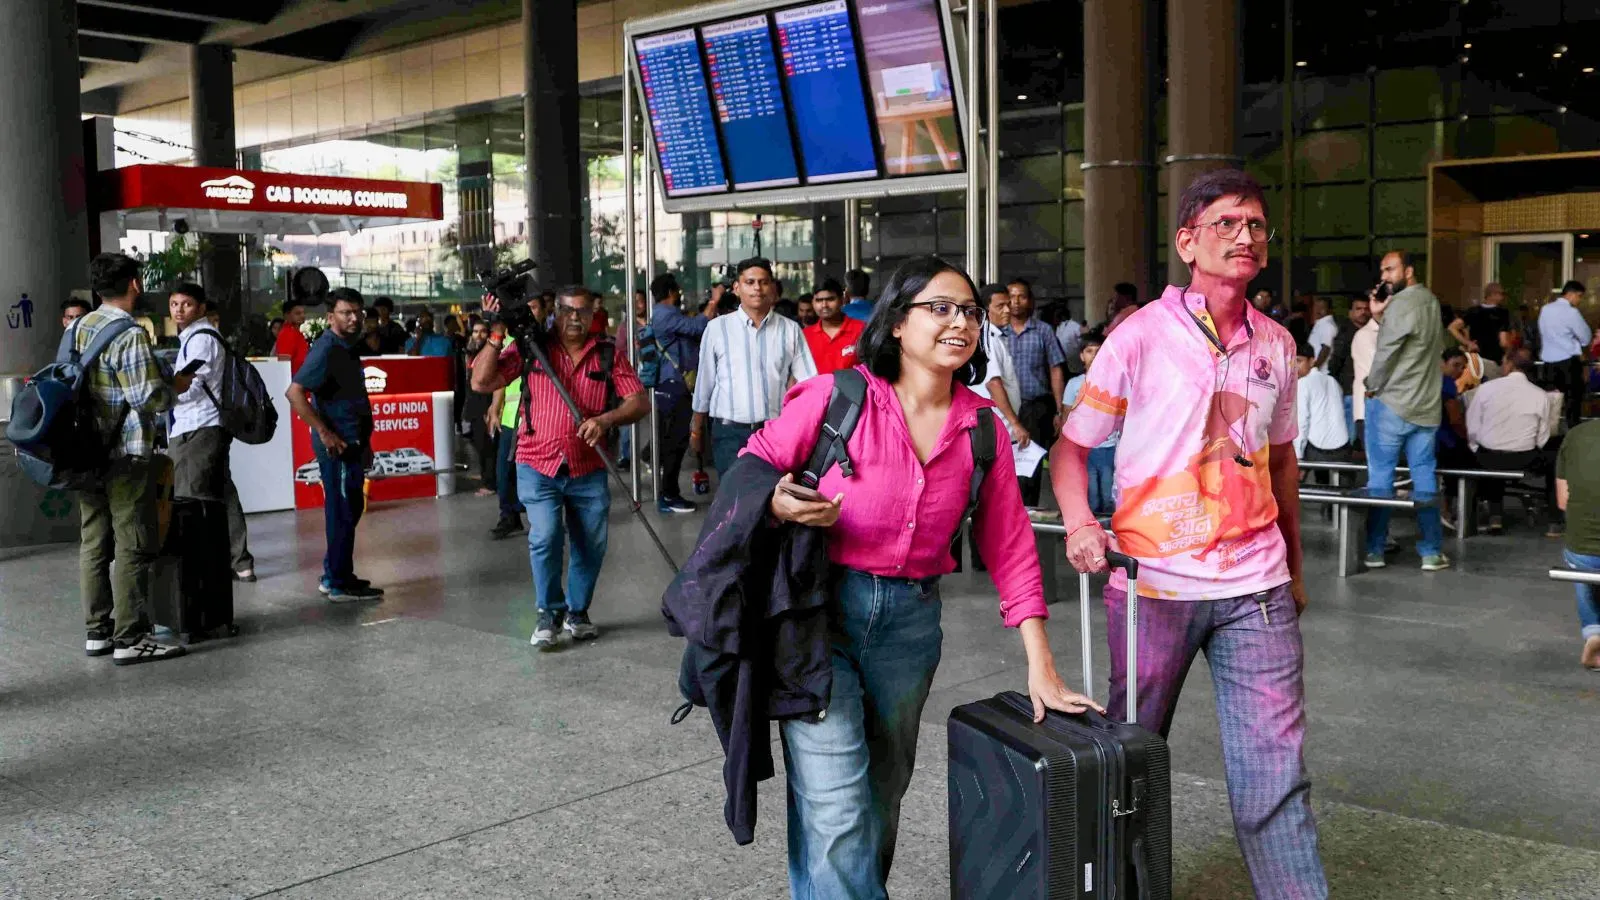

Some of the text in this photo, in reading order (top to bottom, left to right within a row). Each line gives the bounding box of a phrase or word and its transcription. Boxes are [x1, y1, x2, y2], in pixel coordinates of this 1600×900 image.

[265, 185, 408, 209] CAB BOOKING COUNTER
[382, 402, 396, 414] OF
[399, 401, 429, 414] INDIA
[374, 418, 420, 432] SERVICES
